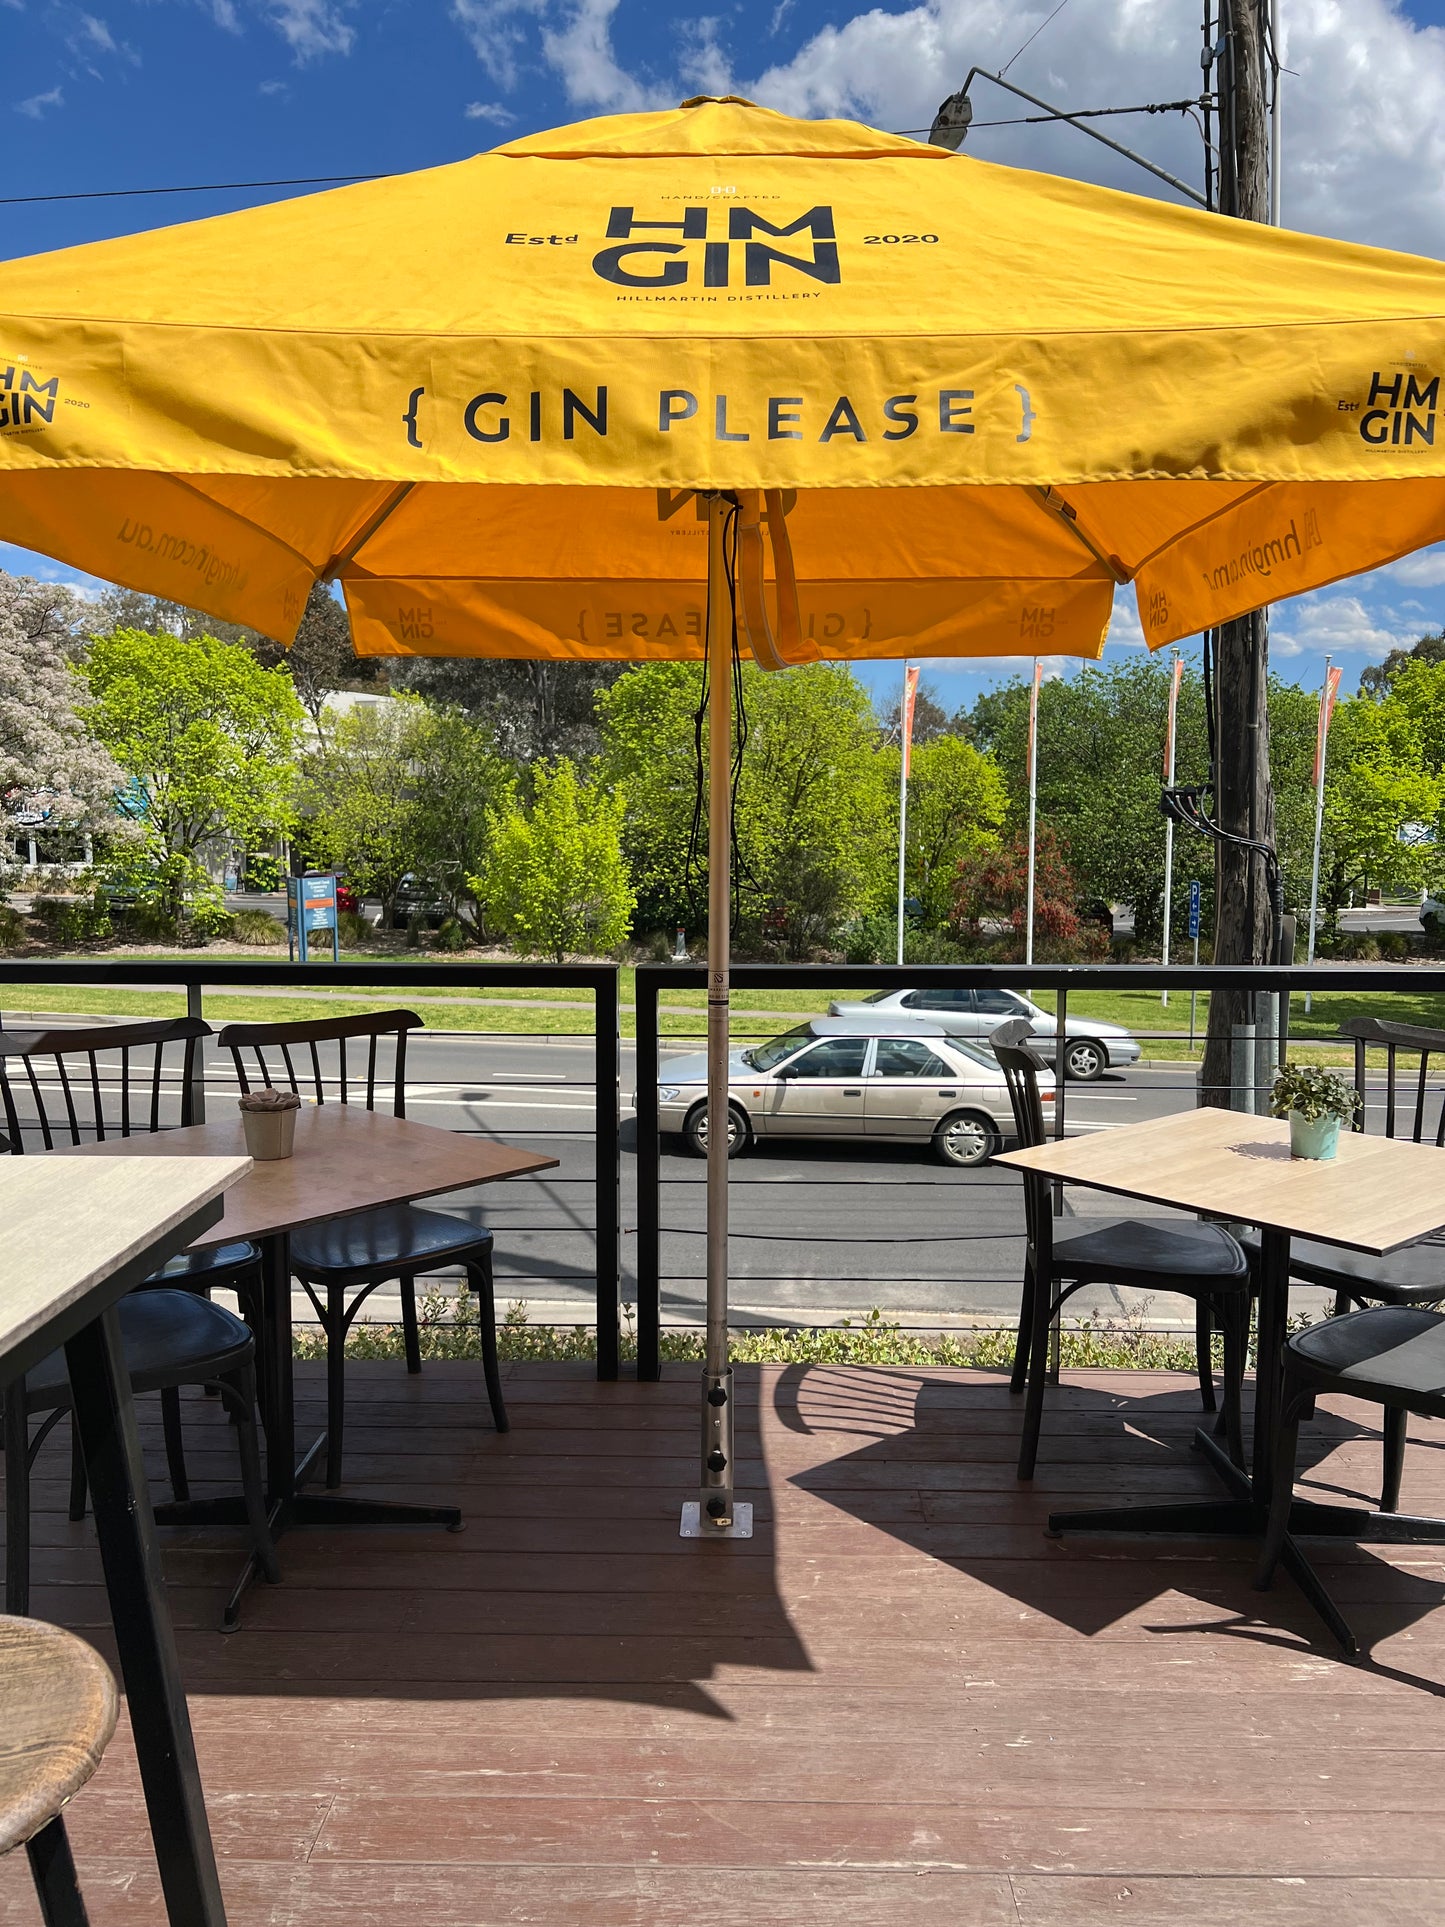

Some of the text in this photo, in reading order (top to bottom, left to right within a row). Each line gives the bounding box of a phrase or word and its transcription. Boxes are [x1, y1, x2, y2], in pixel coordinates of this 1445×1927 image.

[604, 205, 836, 240] HM
[863, 234, 940, 245] 2020
[591, 241, 842, 288] GIN
[727, 291, 822, 302] DISTILLERY
[64, 398, 90, 409] 2020
[1366, 371, 1440, 411] HM
[464, 385, 608, 443] GIN
[658, 389, 976, 443] PLEASE
[1360, 409, 1436, 446] GIN
